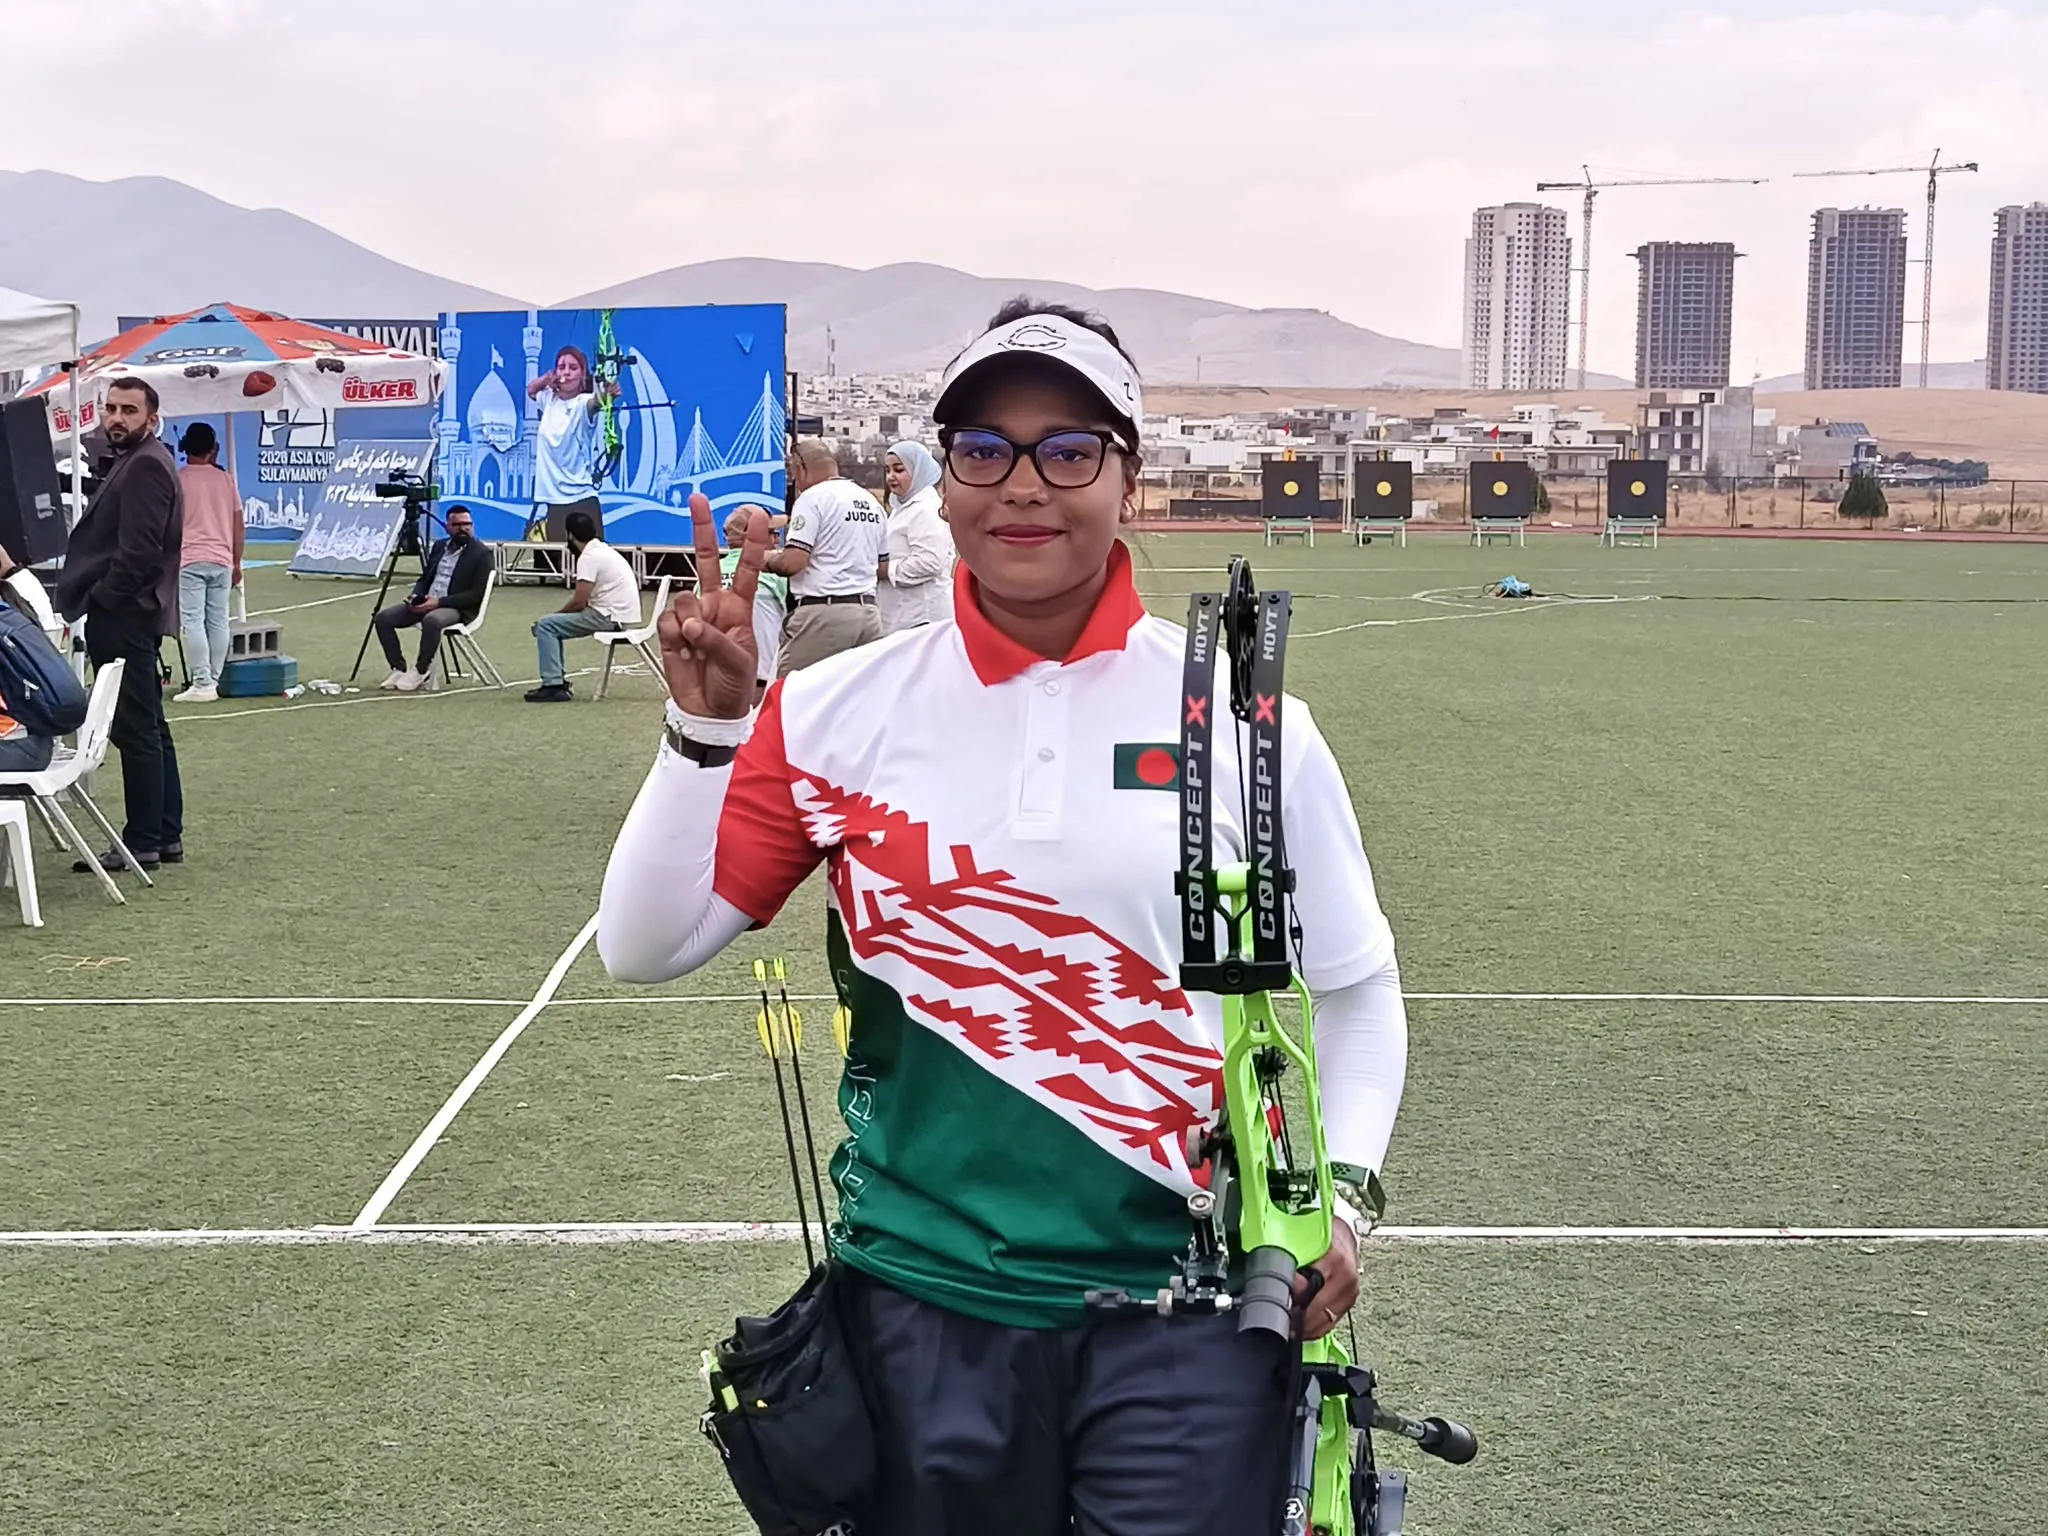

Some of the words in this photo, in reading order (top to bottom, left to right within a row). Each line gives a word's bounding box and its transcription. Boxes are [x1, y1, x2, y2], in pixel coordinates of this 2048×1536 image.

[344, 378, 416, 401] ÜLKER
[54, 402, 95, 430] ÜLER
[261, 468, 328, 481] SULAYMANIYA
[290, 451, 313, 464] ASIA
[315, 452, 336, 465] CUP
[845, 511, 880, 524] JUDGE
[1193, 610, 1210, 663] HOYT
[1262, 608, 1279, 661] HOYT
[1186, 694, 1207, 729] X
[1255, 693, 1276, 727] X
[1186, 732, 1206, 943] CONCEPT
[1256, 730, 1275, 941] CONCEPT
